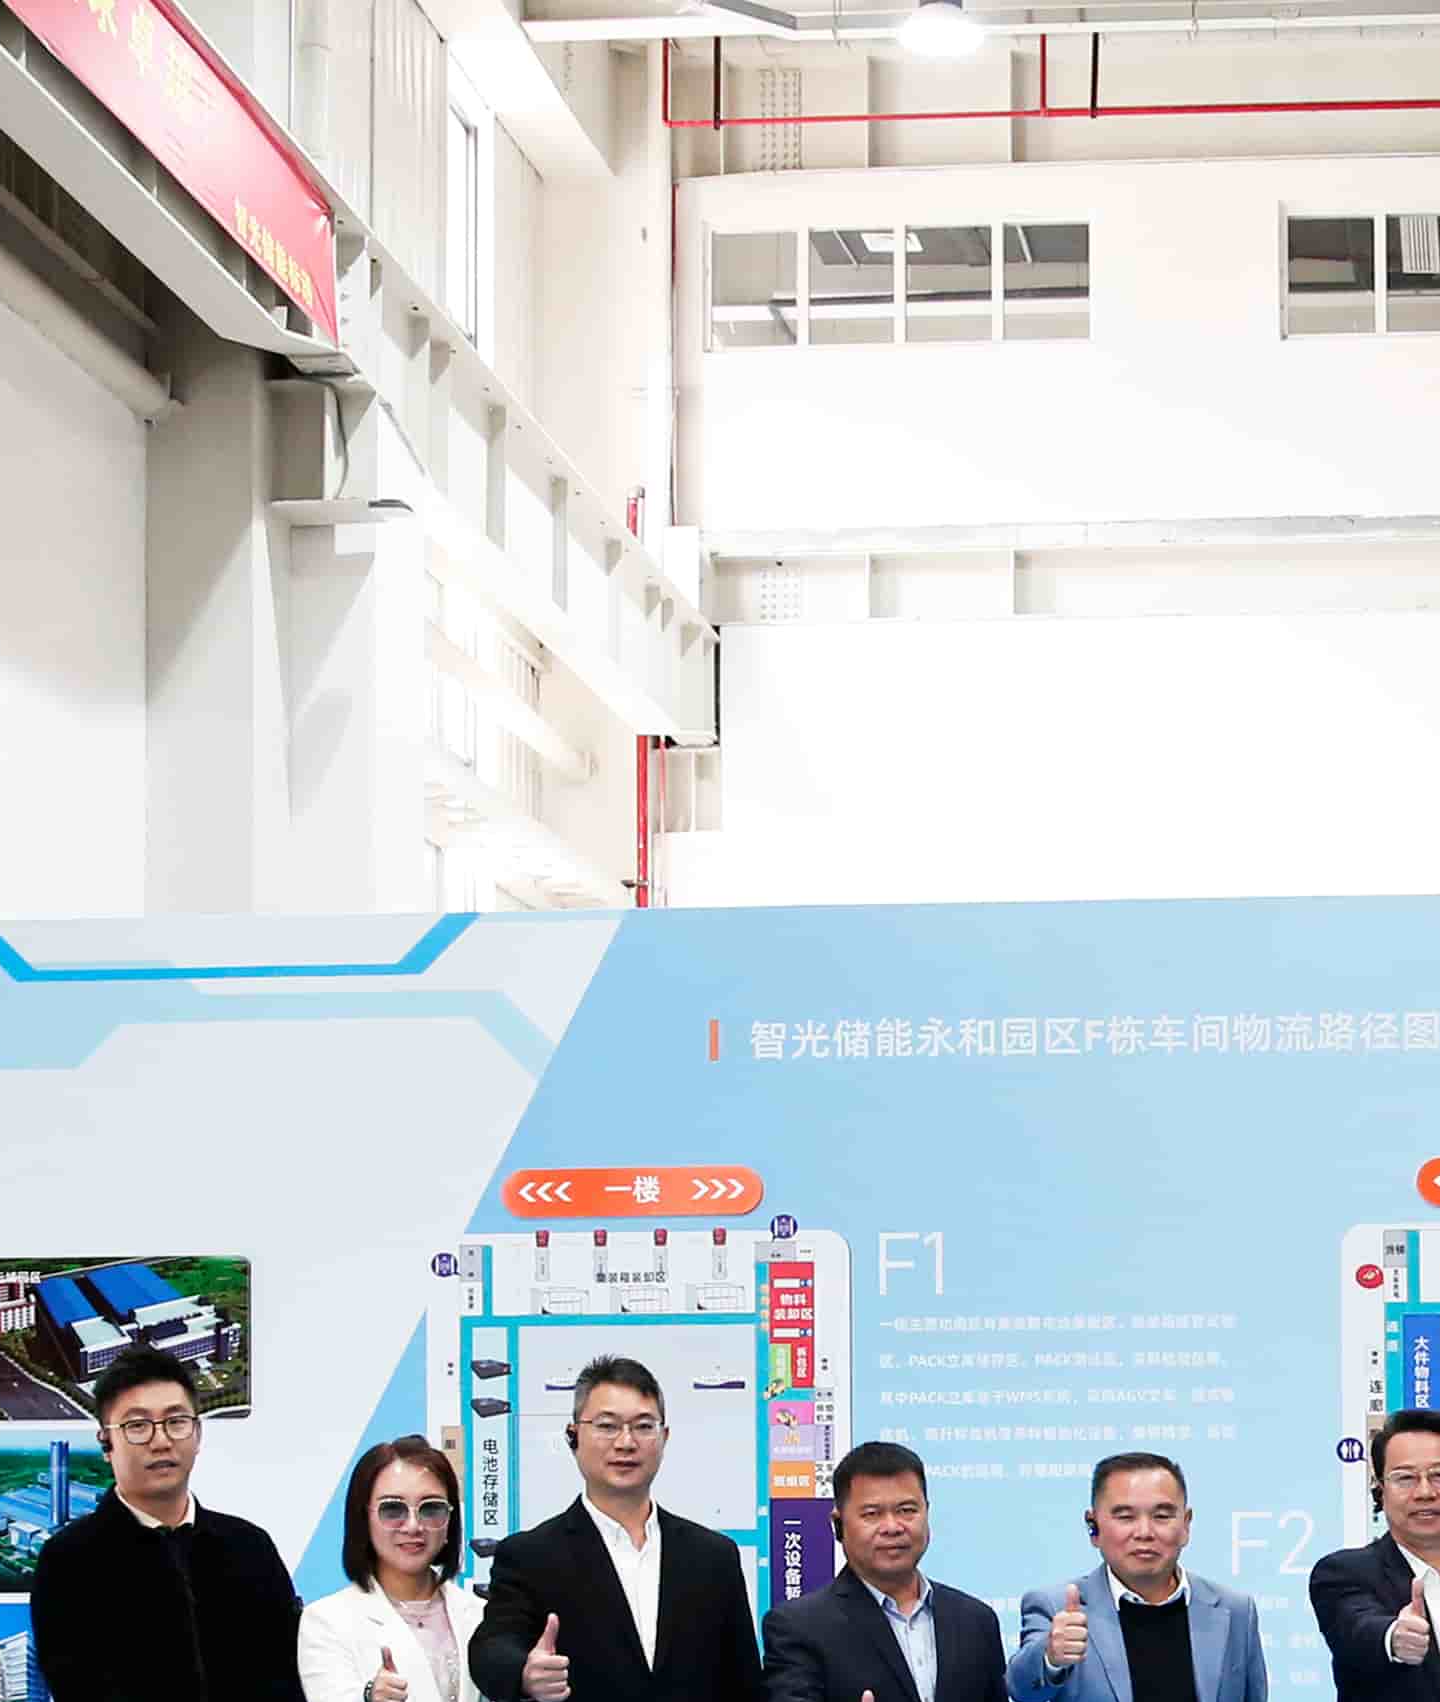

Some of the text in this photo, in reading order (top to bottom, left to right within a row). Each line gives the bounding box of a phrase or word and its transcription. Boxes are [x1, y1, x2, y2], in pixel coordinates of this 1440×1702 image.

[750, 1011, 1440, 1061] 智光储能永和园区F栋车间物流路径图
[604, 1176, 660, 1204] 一楼
[878, 1231, 945, 1297] F1
[482, 1438, 499, 1526] 电池存储区
[1231, 1510, 1314, 1577] F2
